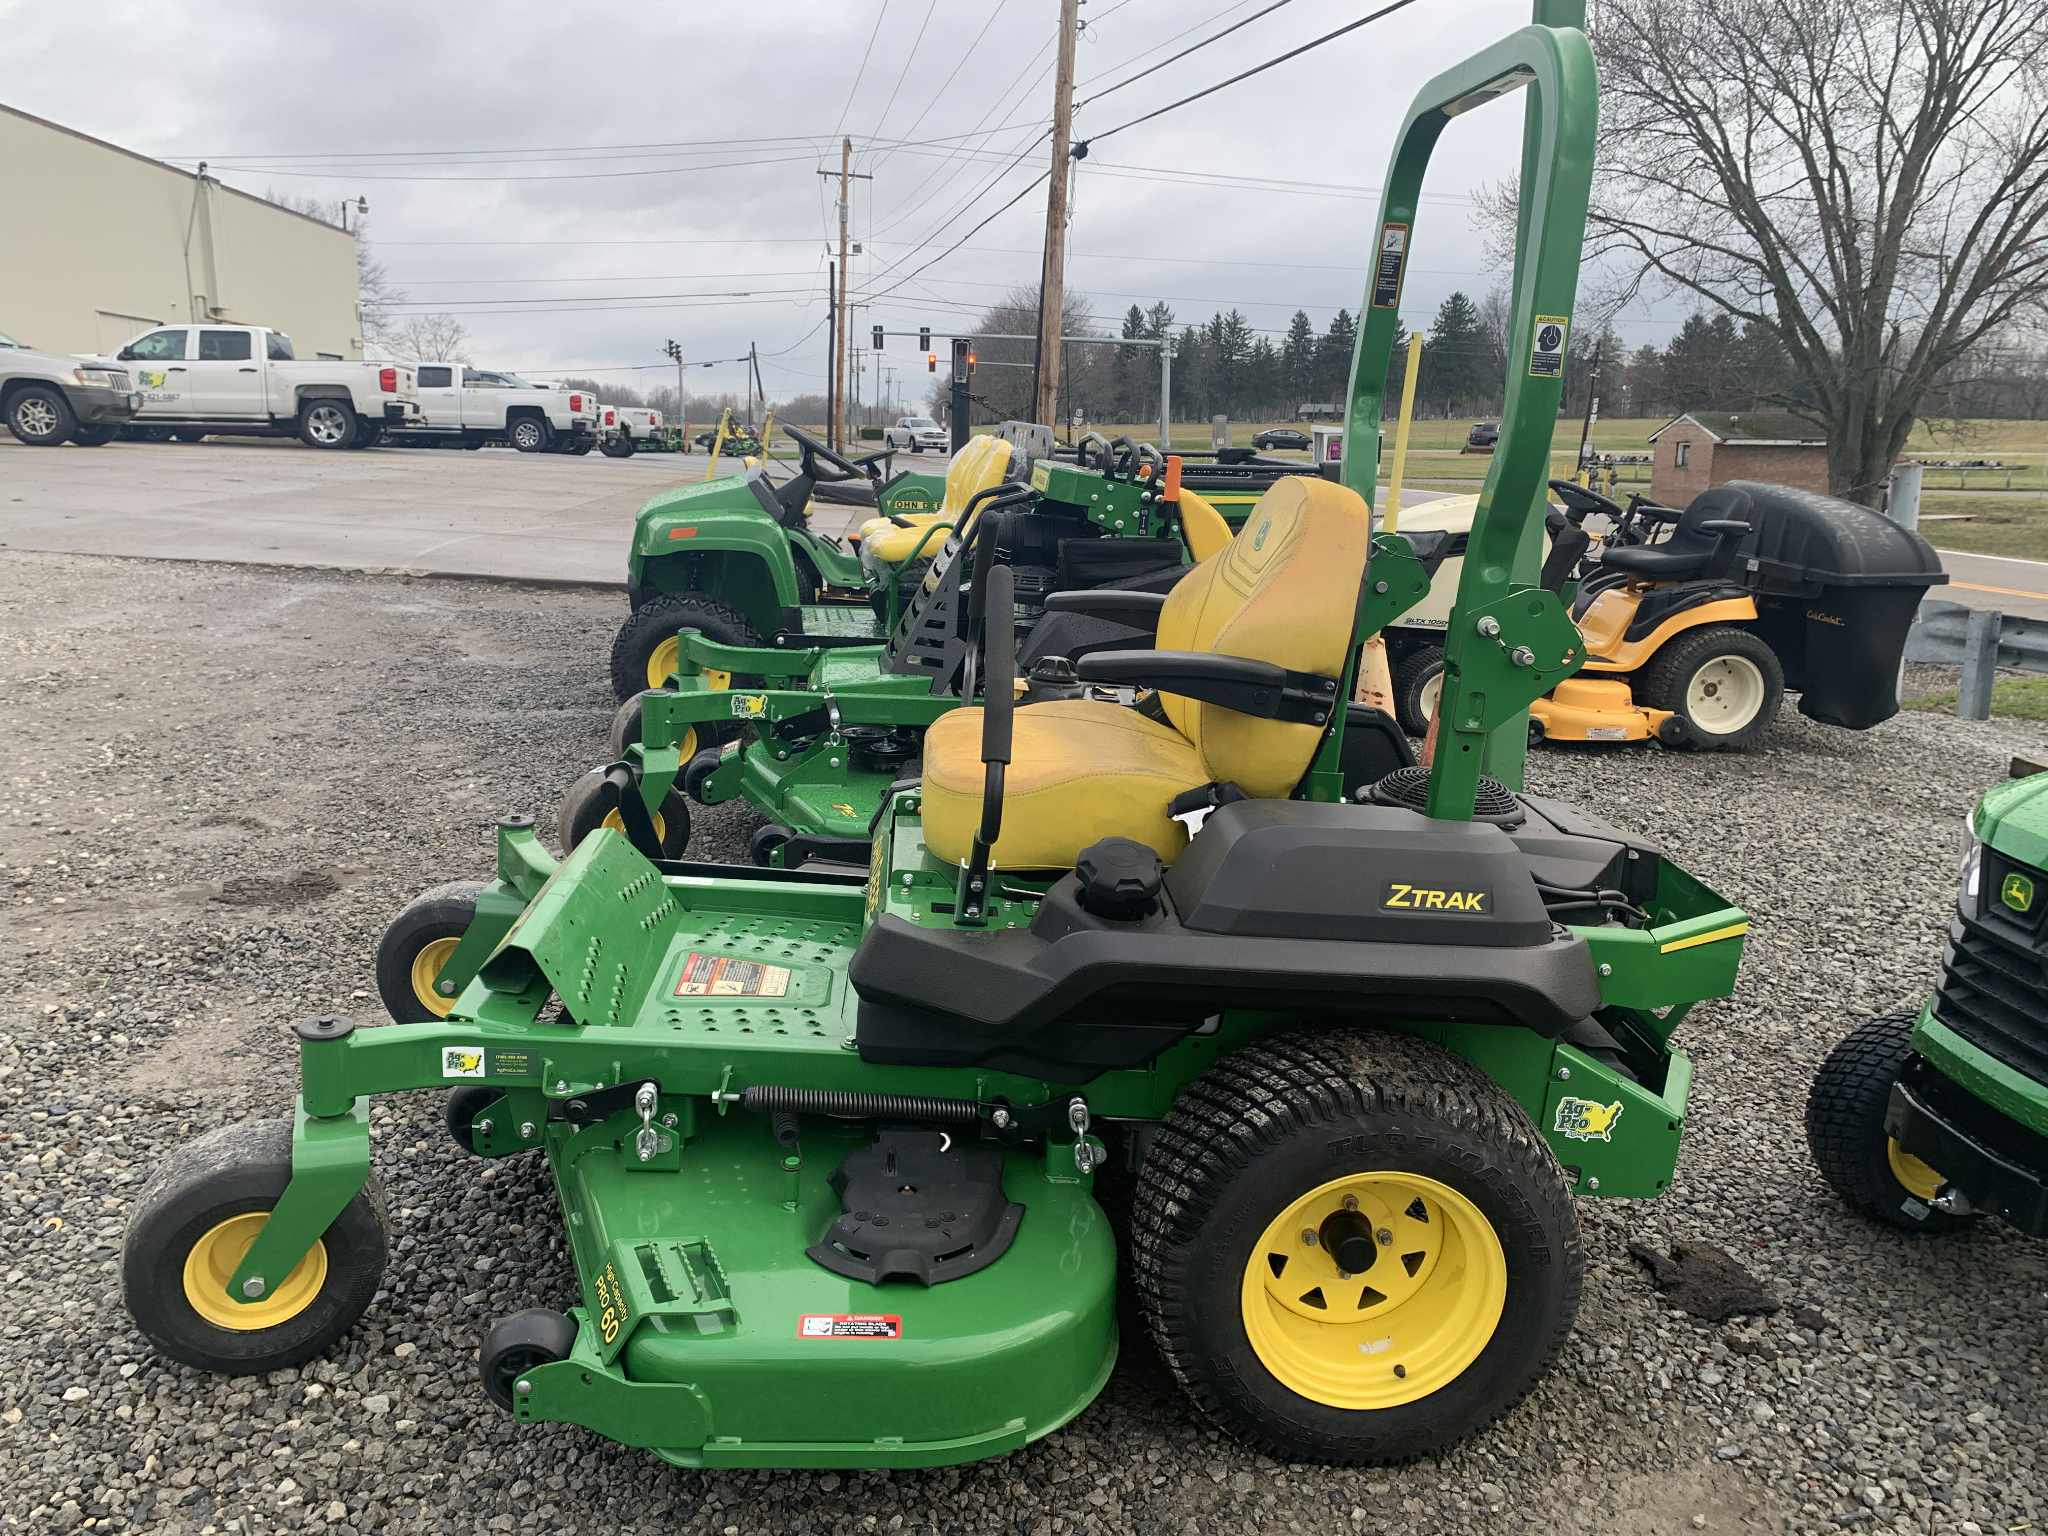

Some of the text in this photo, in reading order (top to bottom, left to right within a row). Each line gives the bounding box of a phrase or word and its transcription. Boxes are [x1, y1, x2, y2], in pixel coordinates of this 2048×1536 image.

[1385, 884, 1485, 911] ZTRAK
[1557, 1114, 1589, 1130] Pro
[595, 1274, 619, 1344] PRO 60
[612, 1280, 629, 1322] Capacity
